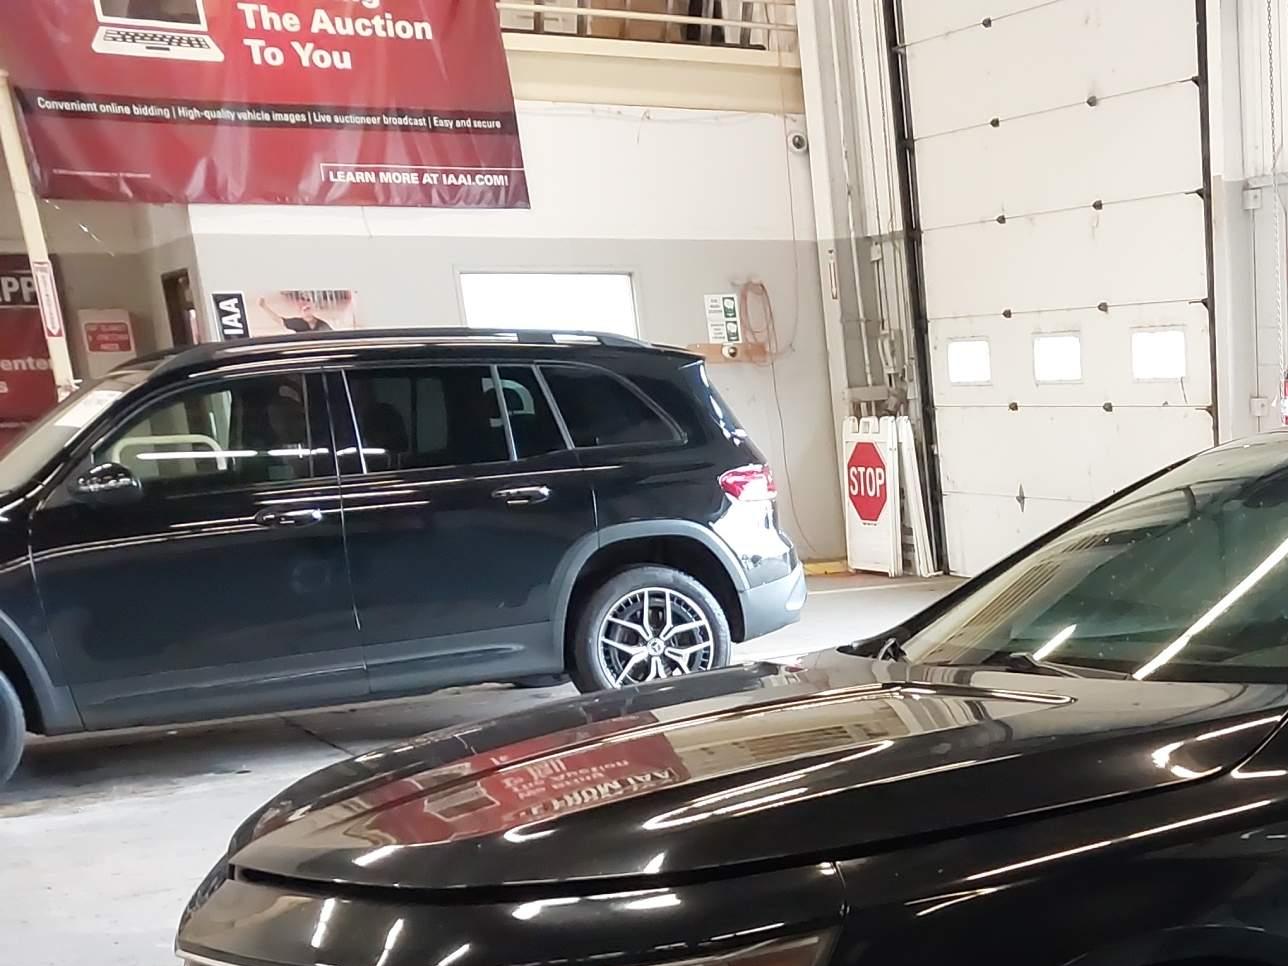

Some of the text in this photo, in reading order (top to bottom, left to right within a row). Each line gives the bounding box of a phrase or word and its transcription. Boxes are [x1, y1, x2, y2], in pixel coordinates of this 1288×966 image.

[237, 2, 433, 40] The Auction
[243, 38, 352, 70] To You
[37, 96, 98, 113] Convenient
[98, 102, 131, 115] online
[133, 104, 171, 119] bidding
[178, 106, 235, 121] High-quality
[237, 108, 270, 121] vehicle
[272, 110, 306, 124] images
[313, 111, 332, 123] Live
[333, 113, 382, 125] auctioneer
[383, 114, 427, 127] broadcast
[433, 116, 454, 129] Easy
[455, 117, 472, 128] and
[473, 118, 502, 129] secure
[329, 170, 509, 186] LEARN MORE AT IAAI.COM!
[219, 297, 244, 335] IAA
[849, 466, 885, 497] STOP
